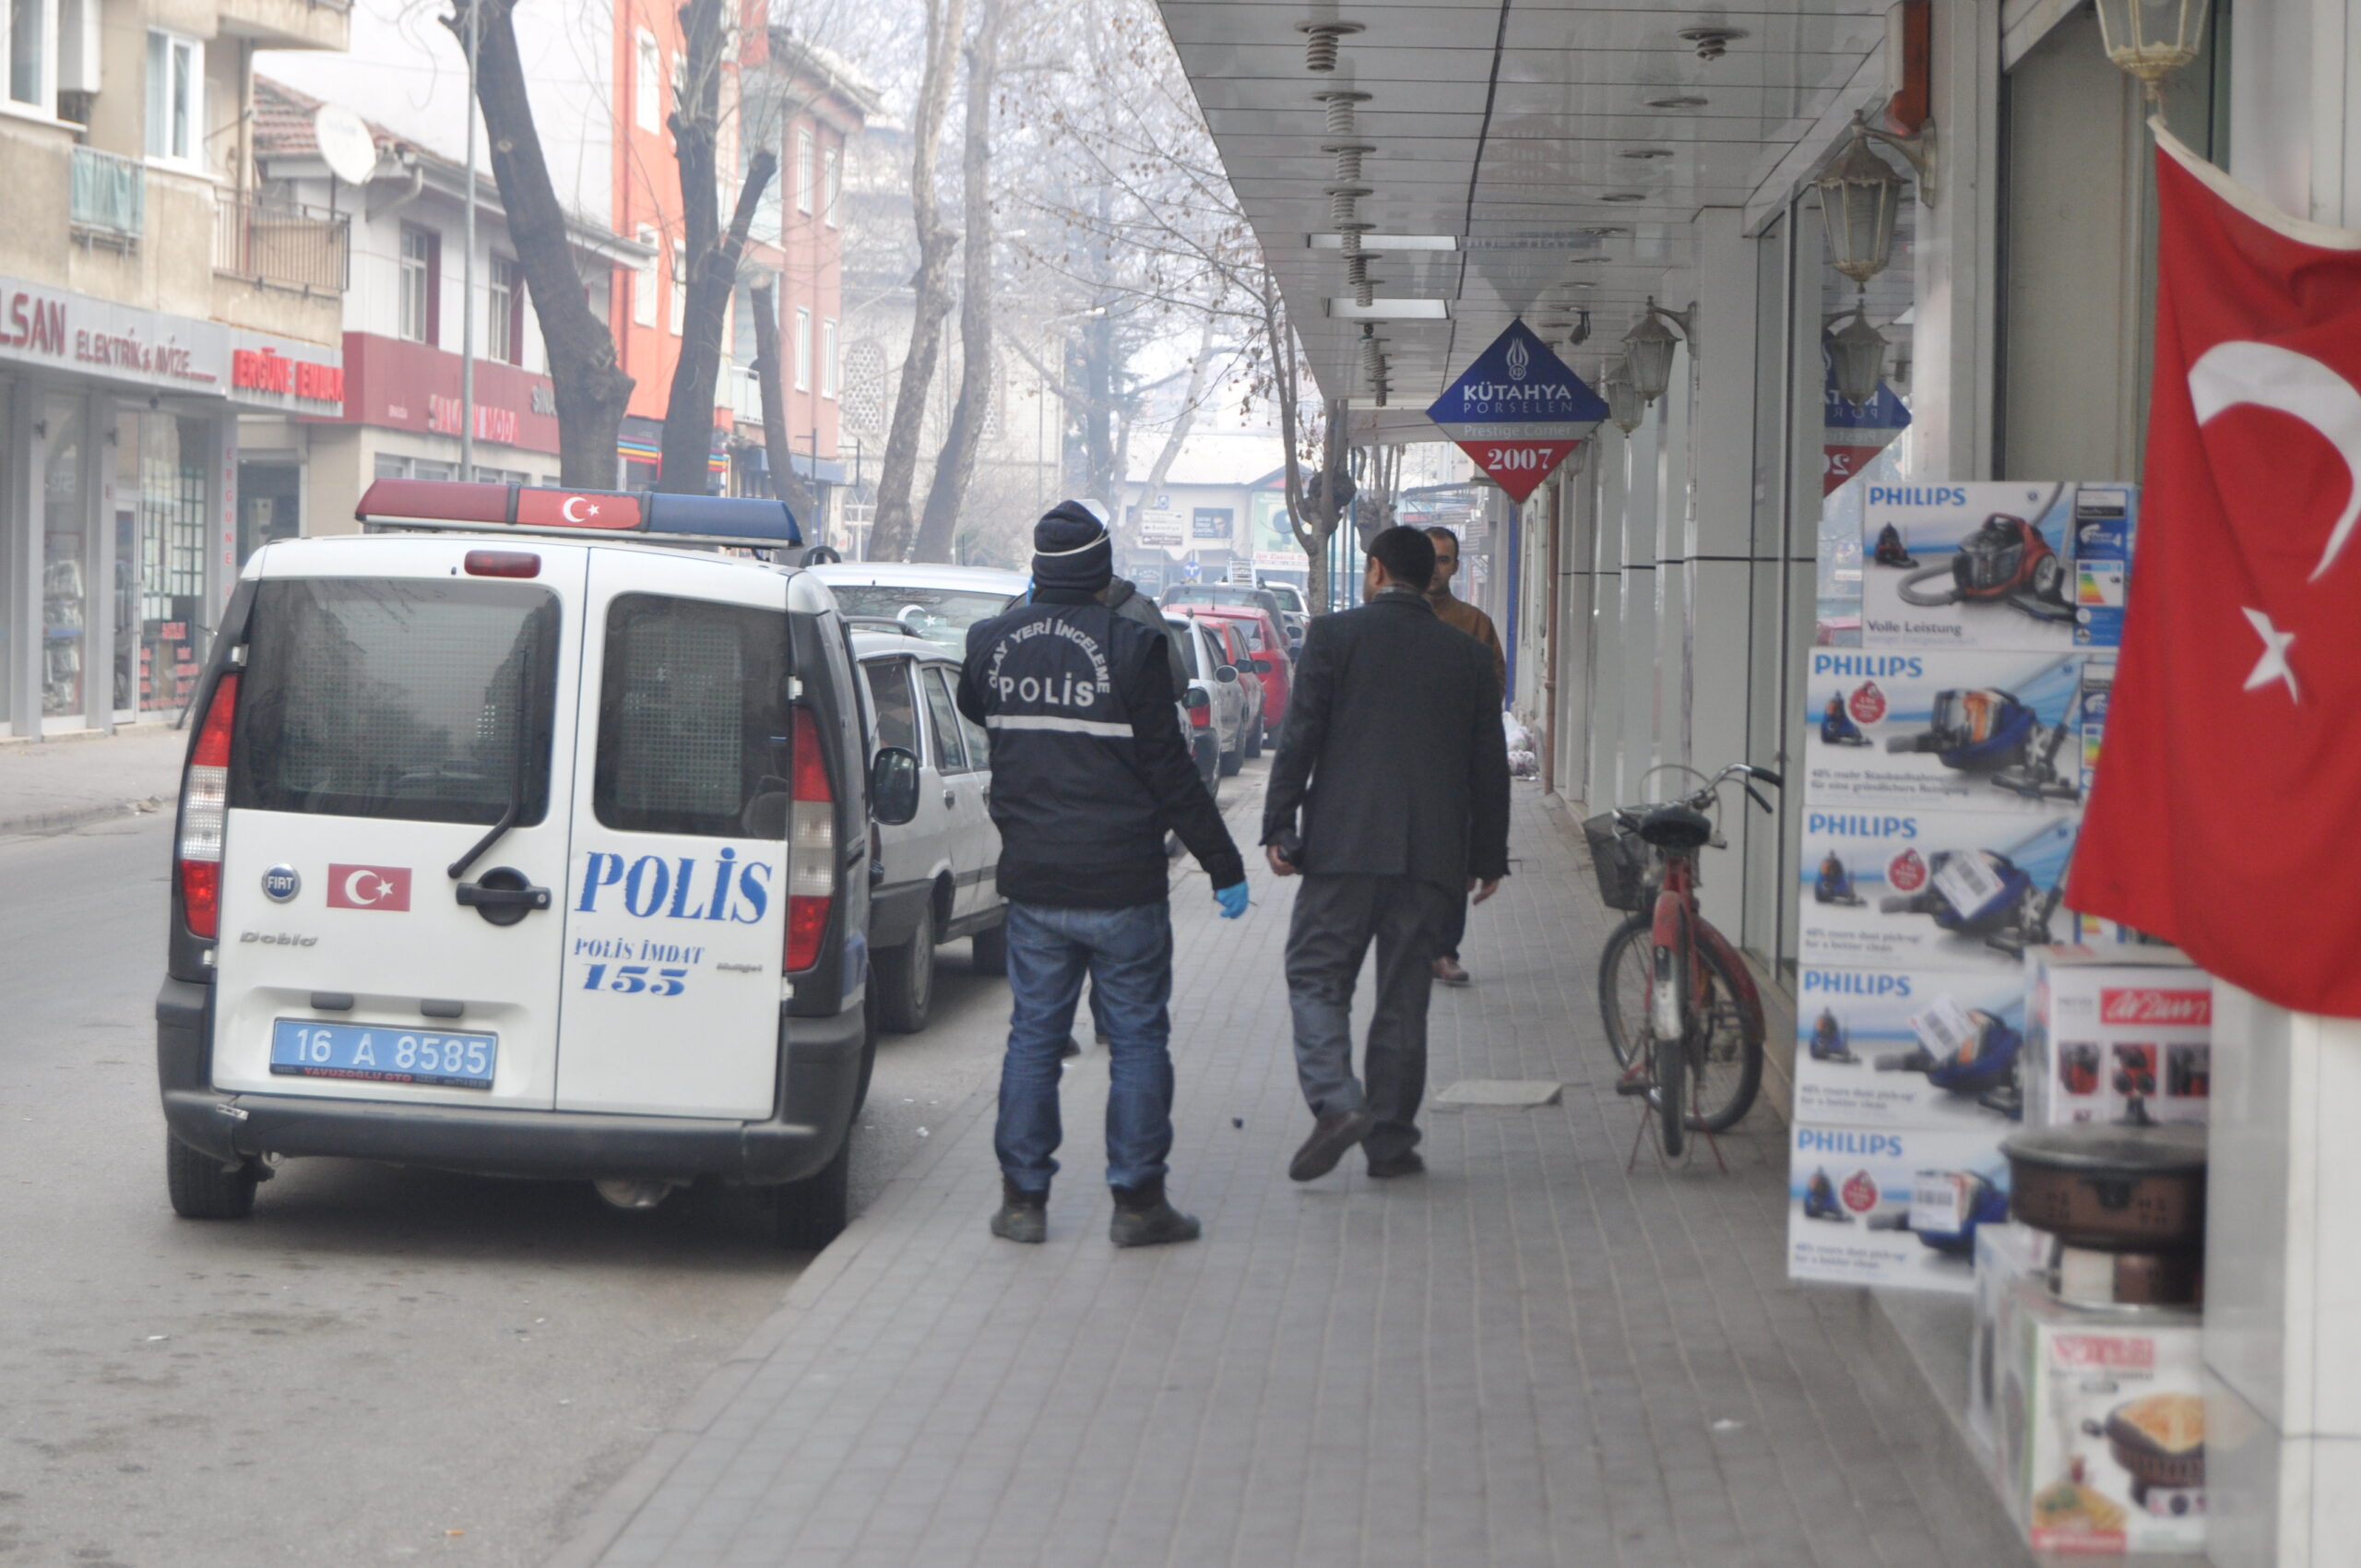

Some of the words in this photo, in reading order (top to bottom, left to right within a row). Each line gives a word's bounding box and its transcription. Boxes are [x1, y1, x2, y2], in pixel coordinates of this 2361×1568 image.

[1463, 381, 1572, 401] KÜTAHYA
[1463, 401, 1573, 414] PORSELEN
[1464, 424, 1520, 439] Prestige
[1524, 424, 1571, 436] Corner
[1487, 447, 1554, 470] 2007
[1869, 487, 1966, 506] PHILIPS
[1867, 620, 1902, 634] Volle
[1904, 620, 1963, 636] Leistung
[989, 640, 1011, 689] OLAY
[1010, 617, 1052, 644] YERİ
[1054, 619, 1110, 694] İNCELEME
[1814, 654, 1923, 678] PHILIPS
[999, 672, 1095, 707] POLİS
[1809, 814, 1917, 838] PHILIPS
[267, 875, 295, 890] FIAT
[574, 847, 773, 924] POLİS
[574, 937, 634, 960] POLİS
[640, 939, 706, 965] İMDAT
[582, 963, 689, 996] 155
[1803, 970, 1911, 997] PHILIPS
[297, 1028, 333, 1063] 16
[352, 1033, 376, 1066] A
[395, 1035, 488, 1075] 8585
[385, 1072, 412, 1083] OTO
[1798, 1128, 1904, 1157] PHILIPS
